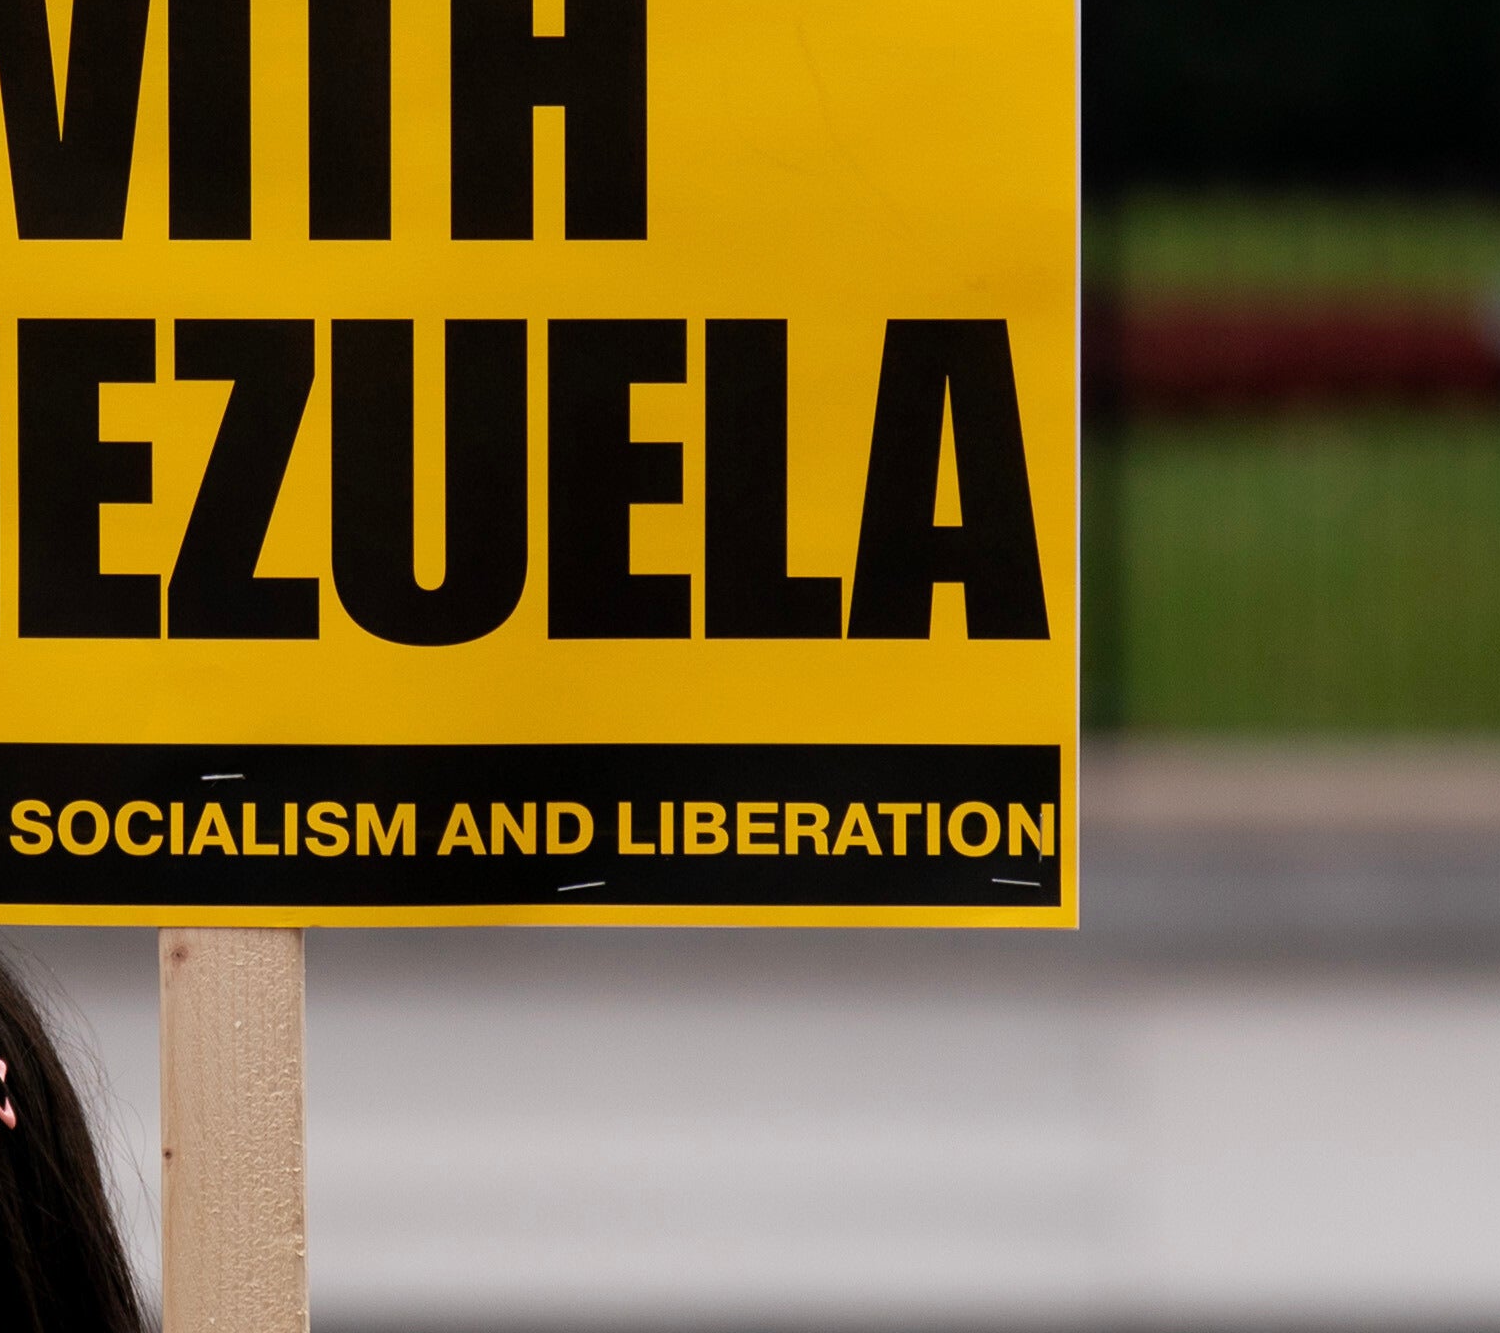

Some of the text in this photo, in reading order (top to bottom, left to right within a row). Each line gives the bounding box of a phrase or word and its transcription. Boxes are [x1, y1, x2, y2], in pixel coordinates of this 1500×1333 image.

[10, 800, 415, 856] SOCIALISM
[438, 802, 593, 855] AND
[619, 802, 1054, 857] LIBERATION
